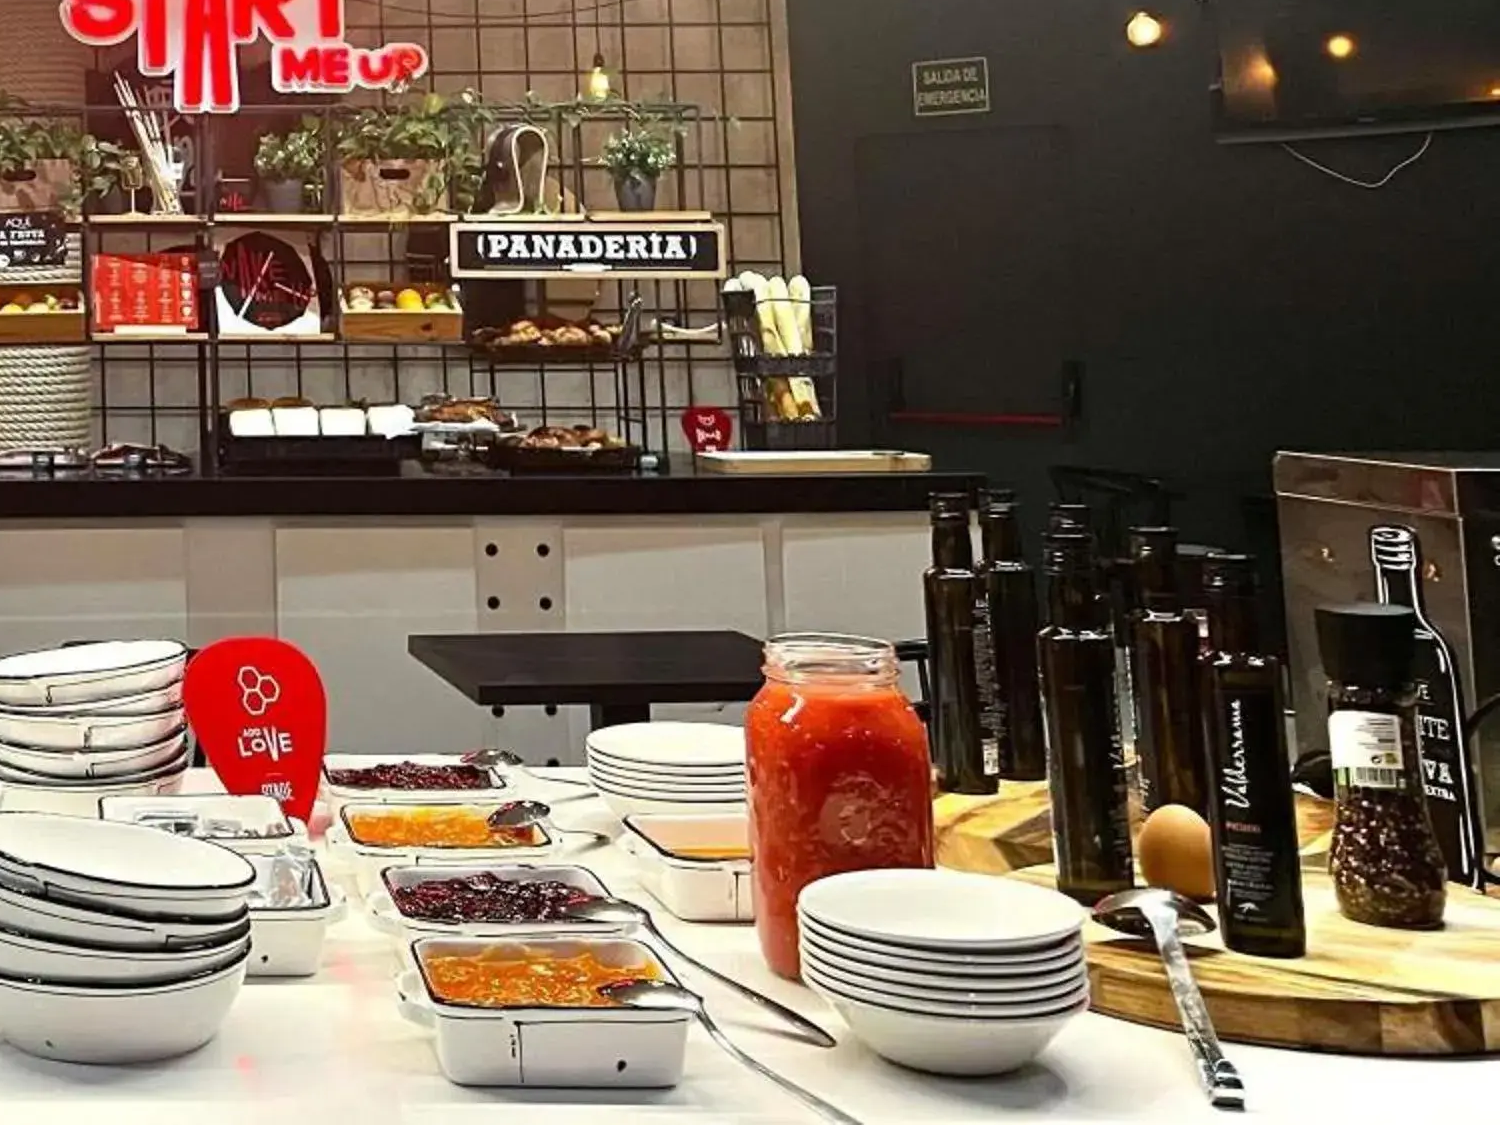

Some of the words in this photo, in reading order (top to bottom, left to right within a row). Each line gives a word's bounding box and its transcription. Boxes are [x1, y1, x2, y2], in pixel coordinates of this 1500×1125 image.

[278, 46, 350, 87] ME
[357, 45, 425, 87] UP
[237, 724, 293, 762] LOVE
[1221, 698, 1251, 809] Valderrama
[1424, 784, 1457, 802] EXTRA
